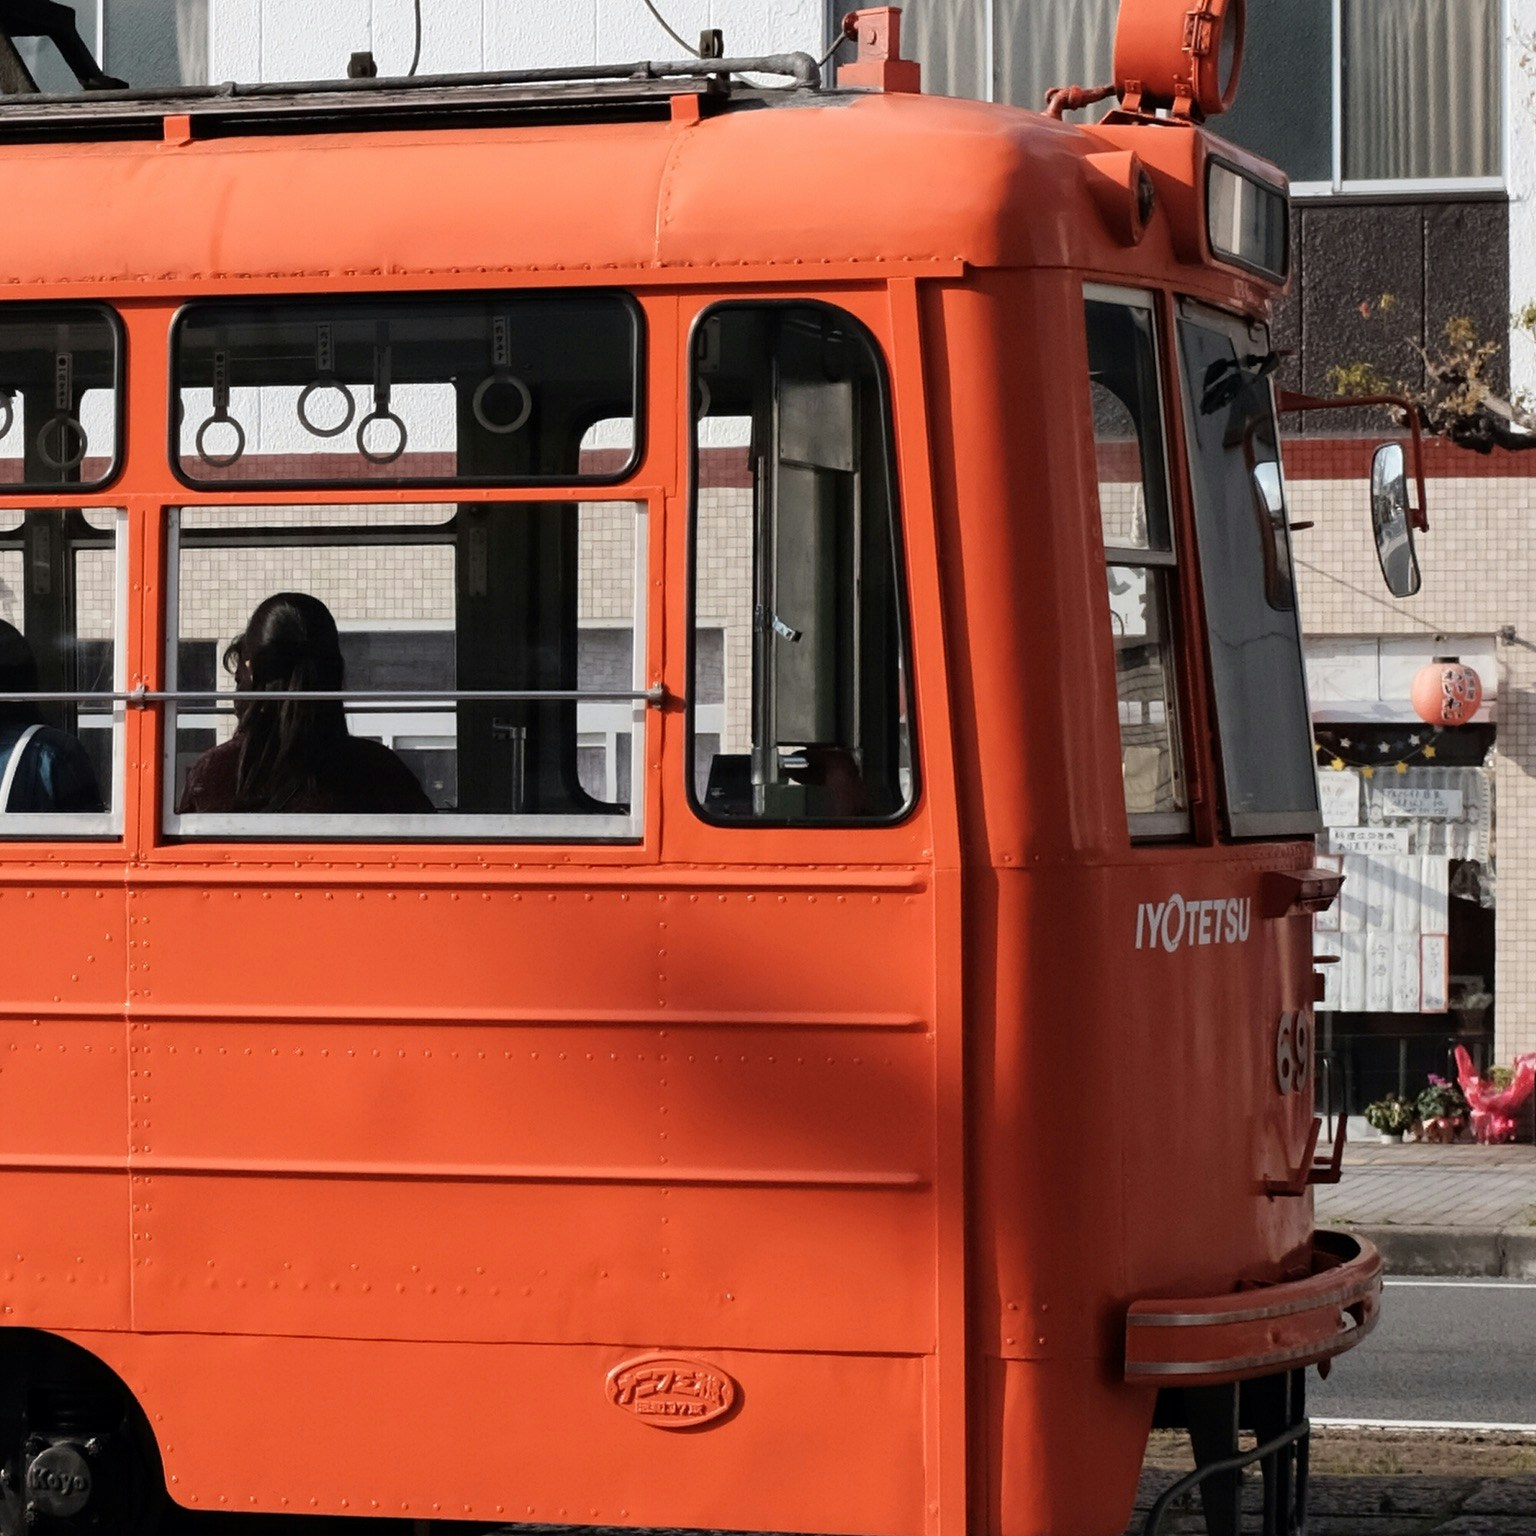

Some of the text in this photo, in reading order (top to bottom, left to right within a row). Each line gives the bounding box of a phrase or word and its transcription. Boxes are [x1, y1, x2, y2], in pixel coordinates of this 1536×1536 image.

[1135, 892, 1251, 953] IYOTETSU
[1276, 1009, 1308, 1096] 69
[31, 1467, 85, 1496] Koyo
